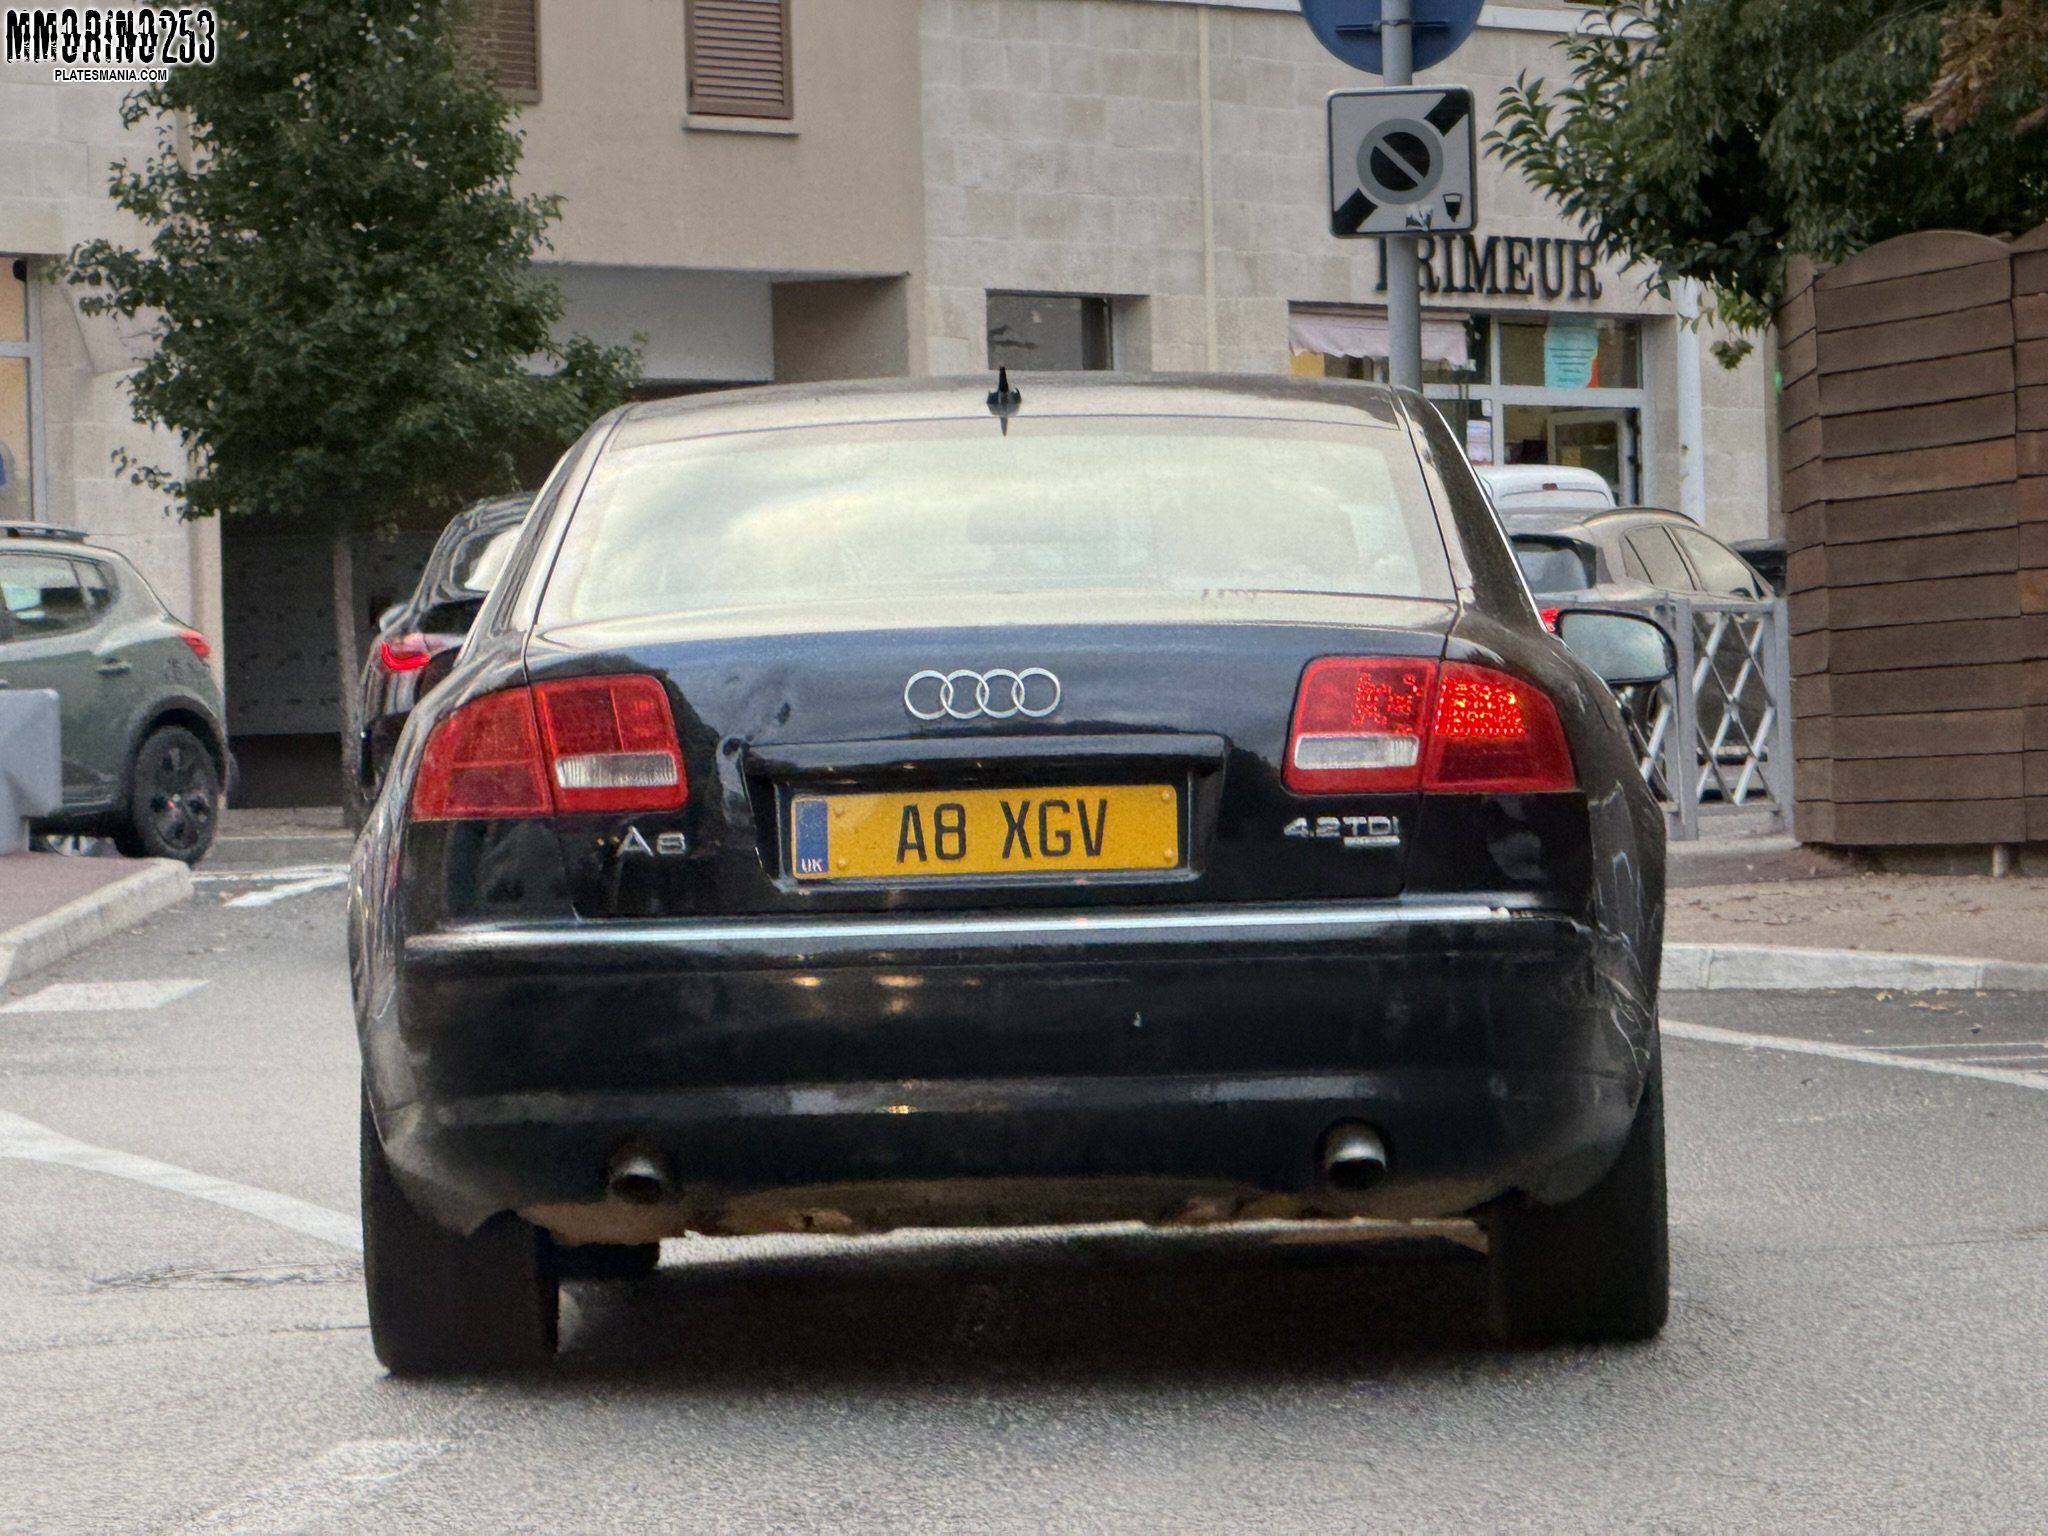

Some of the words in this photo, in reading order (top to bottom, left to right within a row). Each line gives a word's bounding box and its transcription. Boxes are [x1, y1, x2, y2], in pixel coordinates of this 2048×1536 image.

[617, 825, 686, 857] A8
[896, 803, 967, 863] A8
[1000, 798, 1107, 859] XGV
[801, 858, 823, 873] UK
